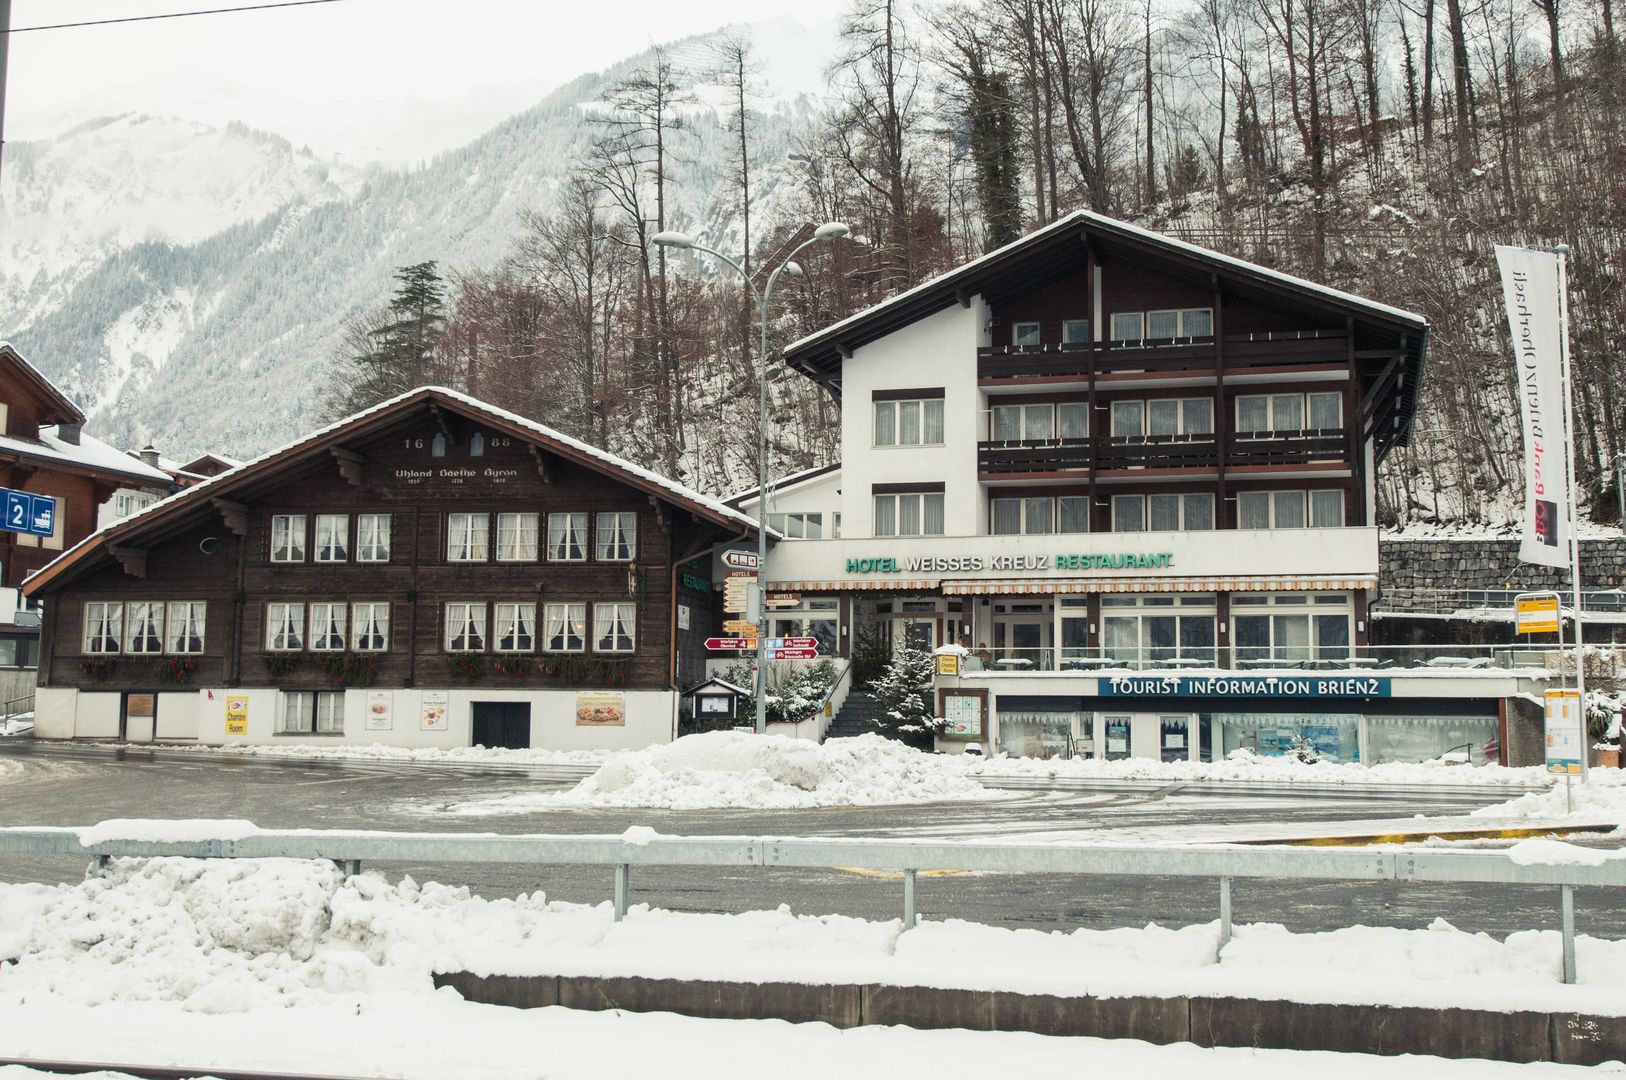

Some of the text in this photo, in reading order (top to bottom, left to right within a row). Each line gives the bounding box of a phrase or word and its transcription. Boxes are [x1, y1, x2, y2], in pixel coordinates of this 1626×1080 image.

[405, 439, 424, 449] 16
[395, 467, 518, 478] Uhland Goethe Byron
[12, 504, 24, 525] 2
[846, 552, 1173, 572] HOTEL WEISSES KREUZ RESTAURANT
[1110, 679, 1379, 694] TOURIST INFORMATION BRIENZ
[227, 713, 246, 721] Chambre
[228, 724, 244, 733] Room
